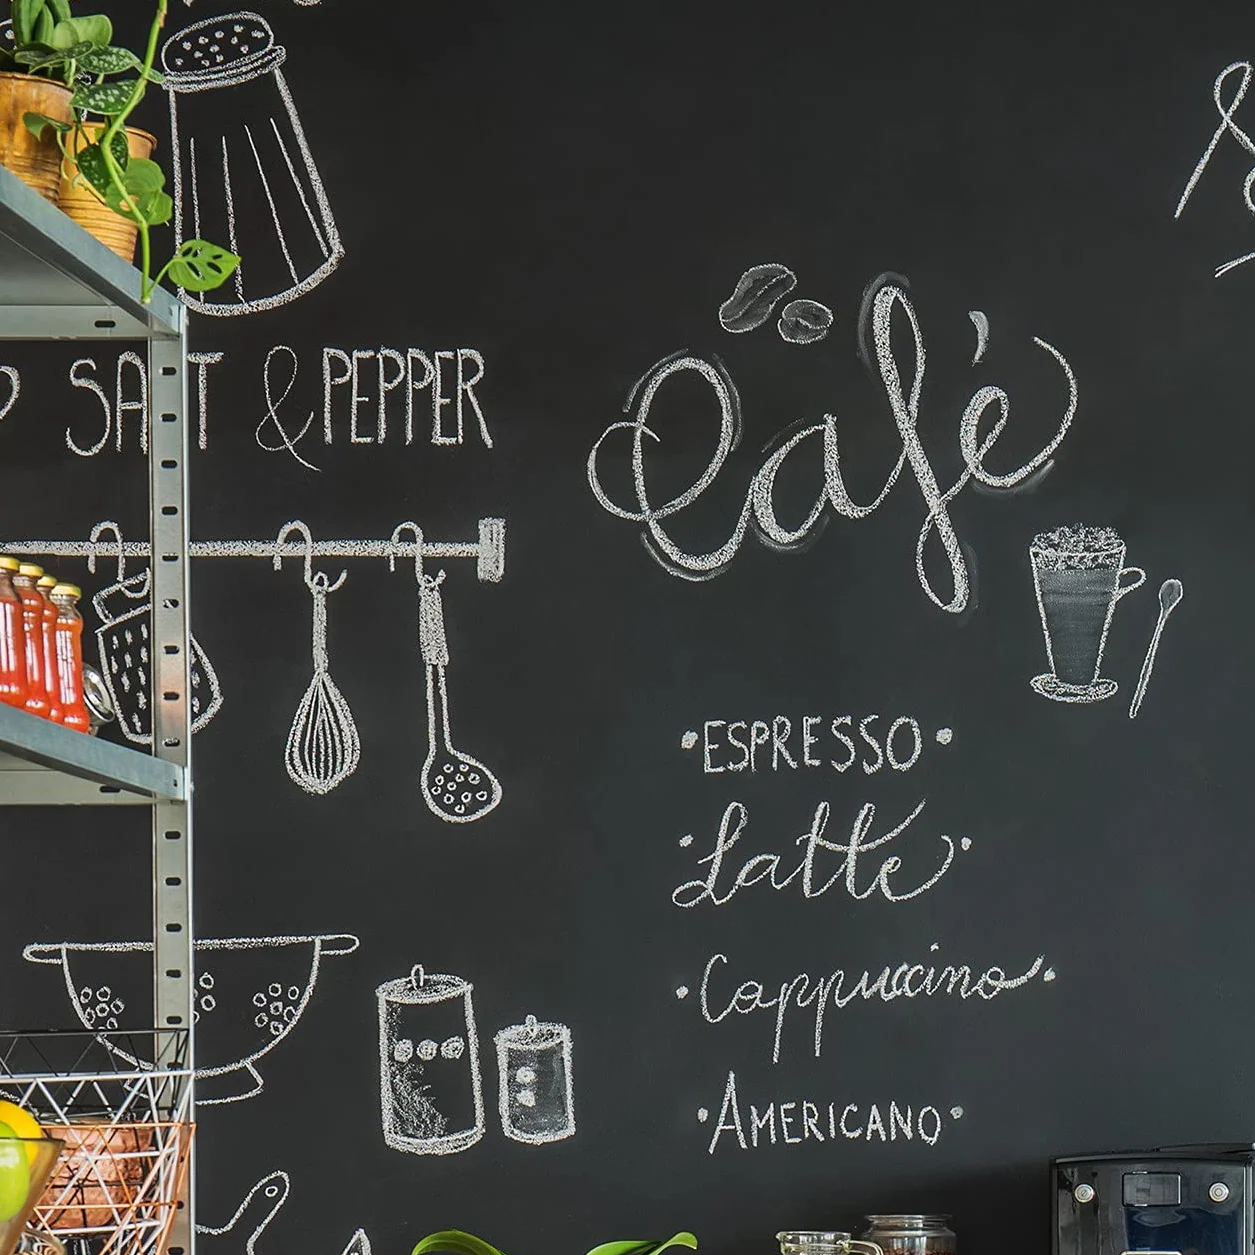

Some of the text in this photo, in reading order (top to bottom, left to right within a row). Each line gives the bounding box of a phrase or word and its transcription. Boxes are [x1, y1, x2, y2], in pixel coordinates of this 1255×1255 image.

[66, 346, 493, 472] SAT & PEPPER
[705, 716, 923, 776] ESPRESSO
[673, 800, 955, 908] Latte
[701, 944, 1045, 1065] Cappuccino
